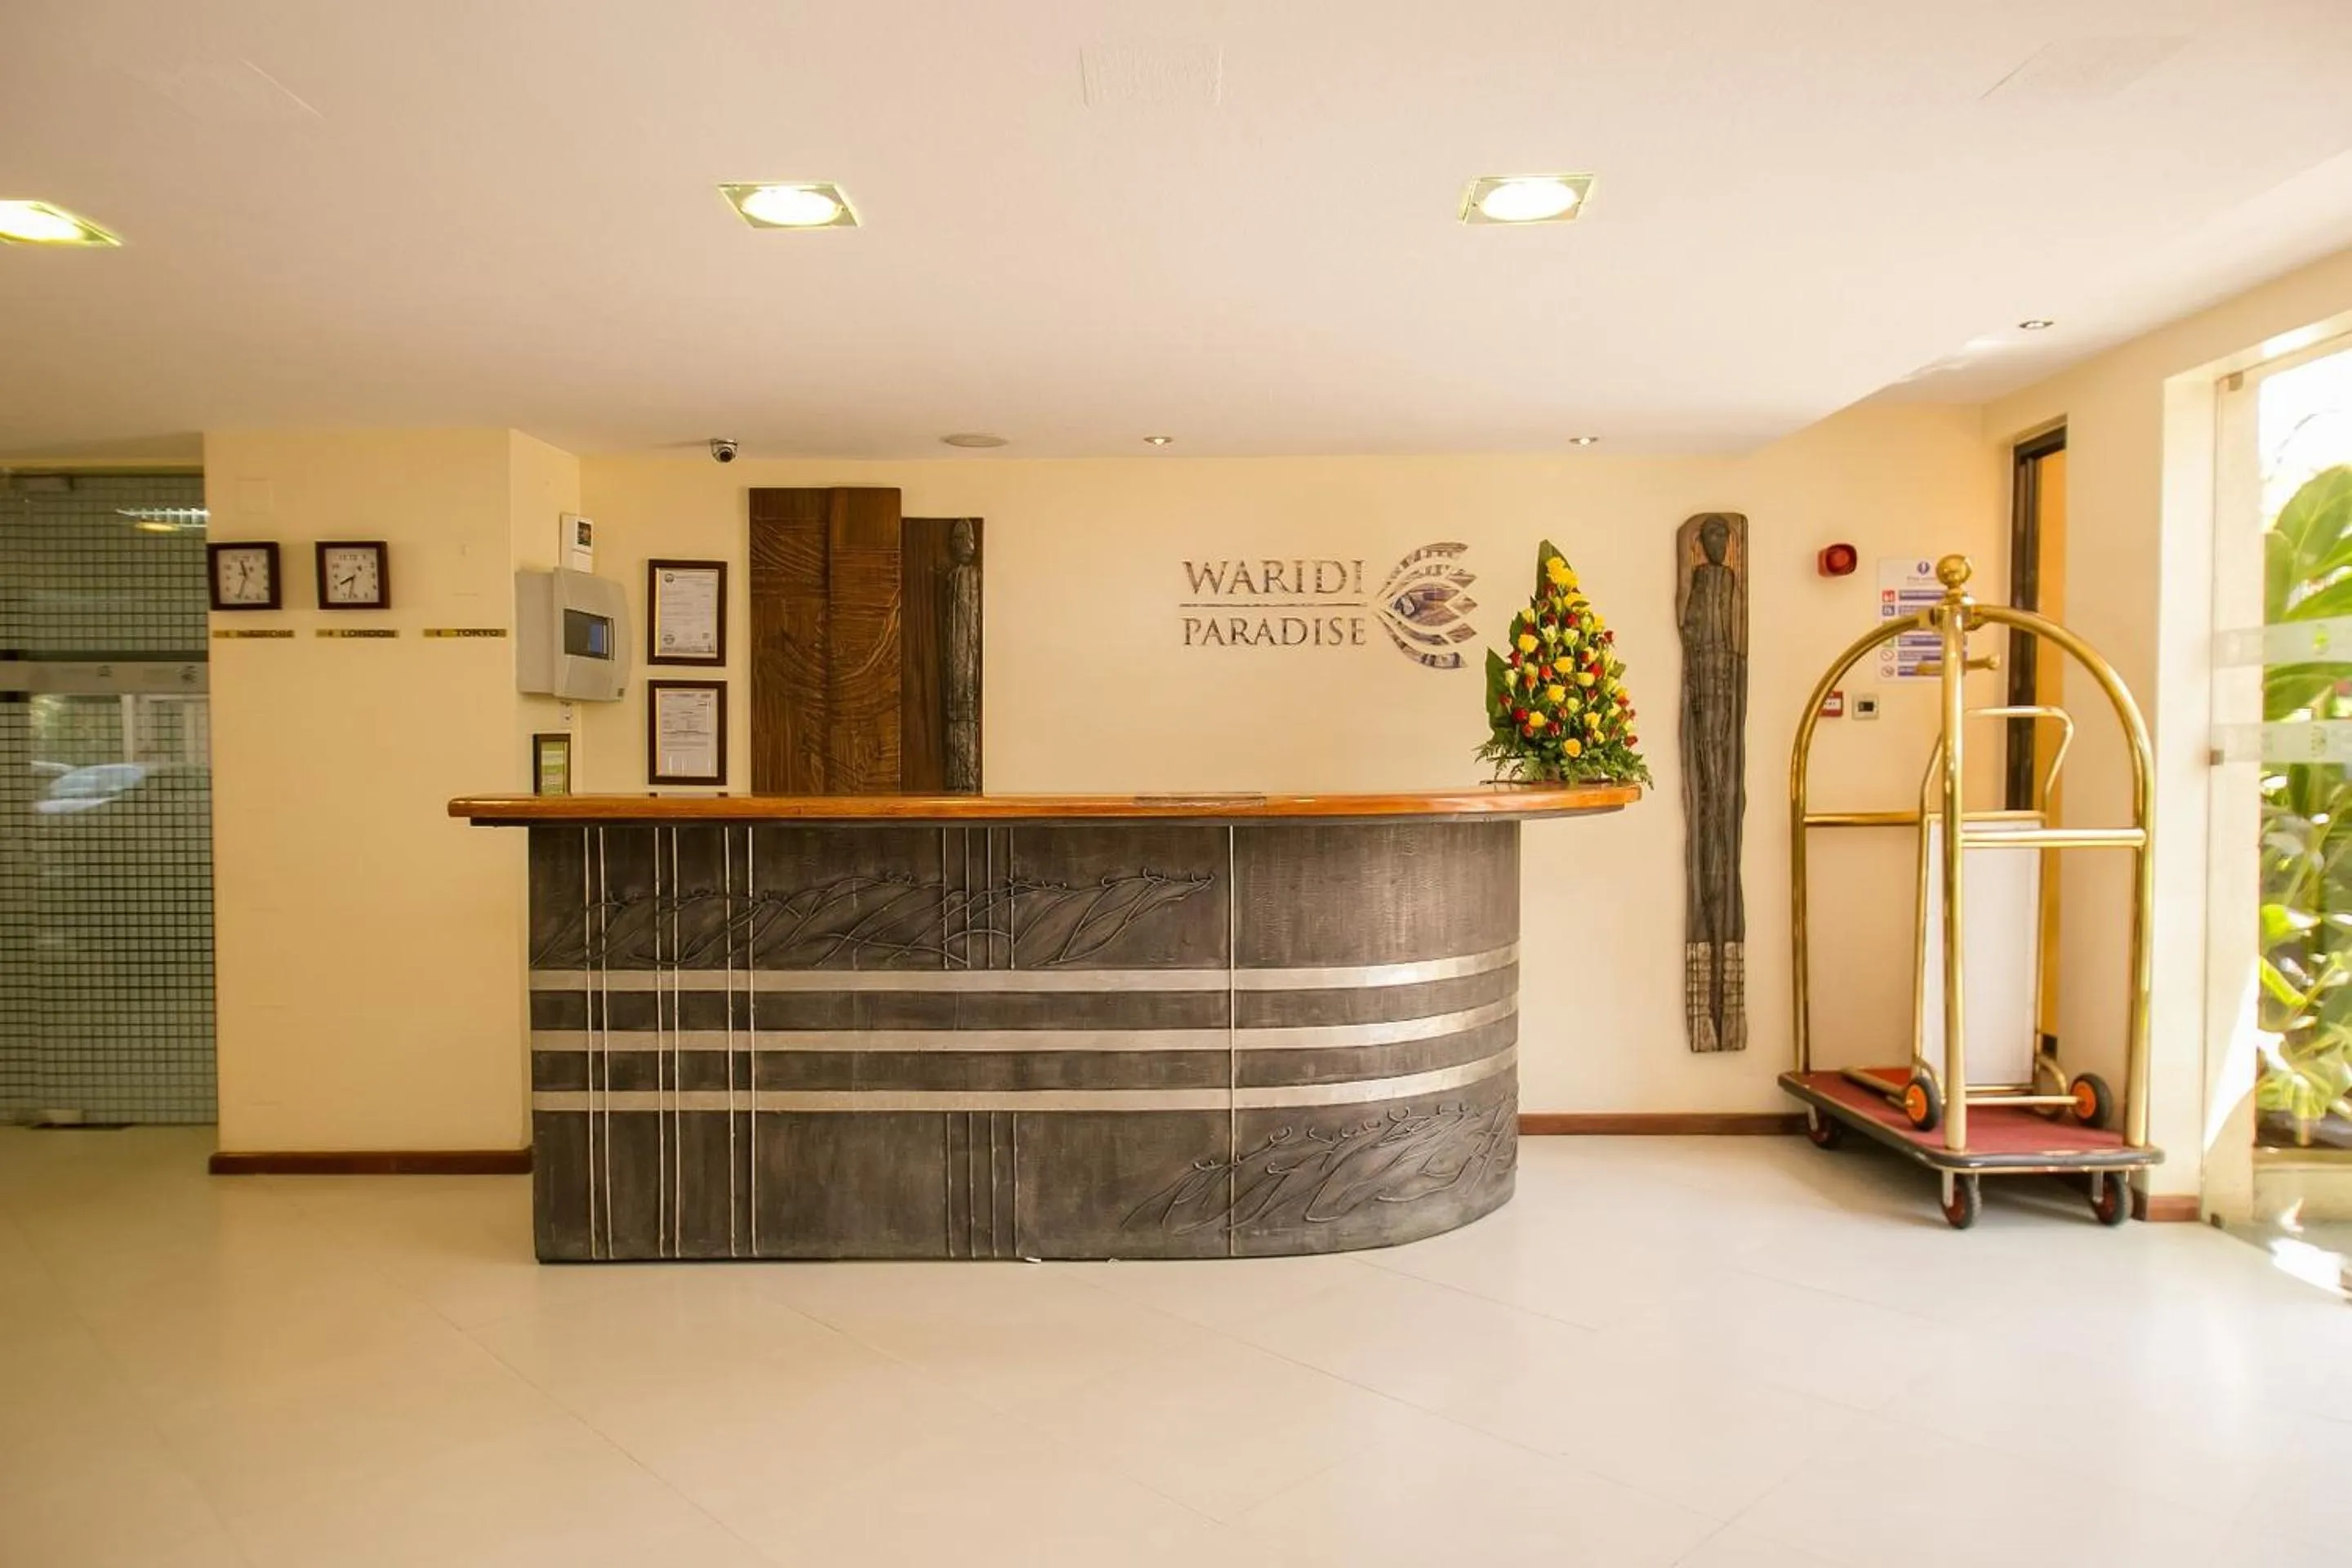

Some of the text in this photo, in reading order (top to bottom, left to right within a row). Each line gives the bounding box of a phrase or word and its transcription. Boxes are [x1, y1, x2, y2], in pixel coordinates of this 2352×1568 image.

[1182, 560, 1365, 595] WARIDI
[341, 630, 395, 638] LONDON
[454, 629, 499, 638] TOKYO
[1182, 617, 1366, 646] PARADISE
